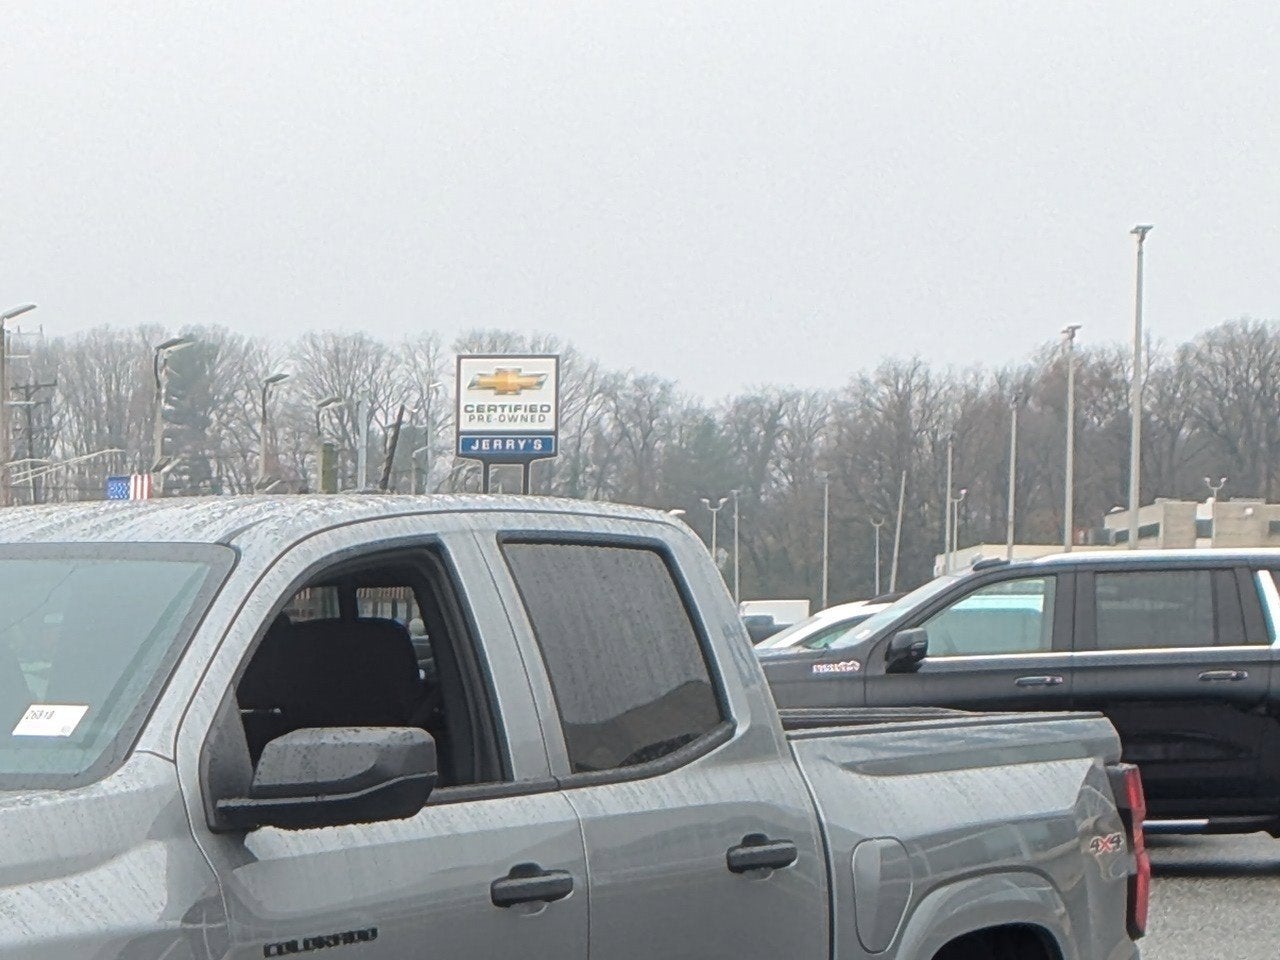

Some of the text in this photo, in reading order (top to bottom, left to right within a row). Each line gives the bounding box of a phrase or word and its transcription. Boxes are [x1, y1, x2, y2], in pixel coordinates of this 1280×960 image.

[463, 404, 552, 414] CERTIFIED
[468, 413, 547, 423] PRE-OWNED
[470, 439, 543, 451] JERRY'S
